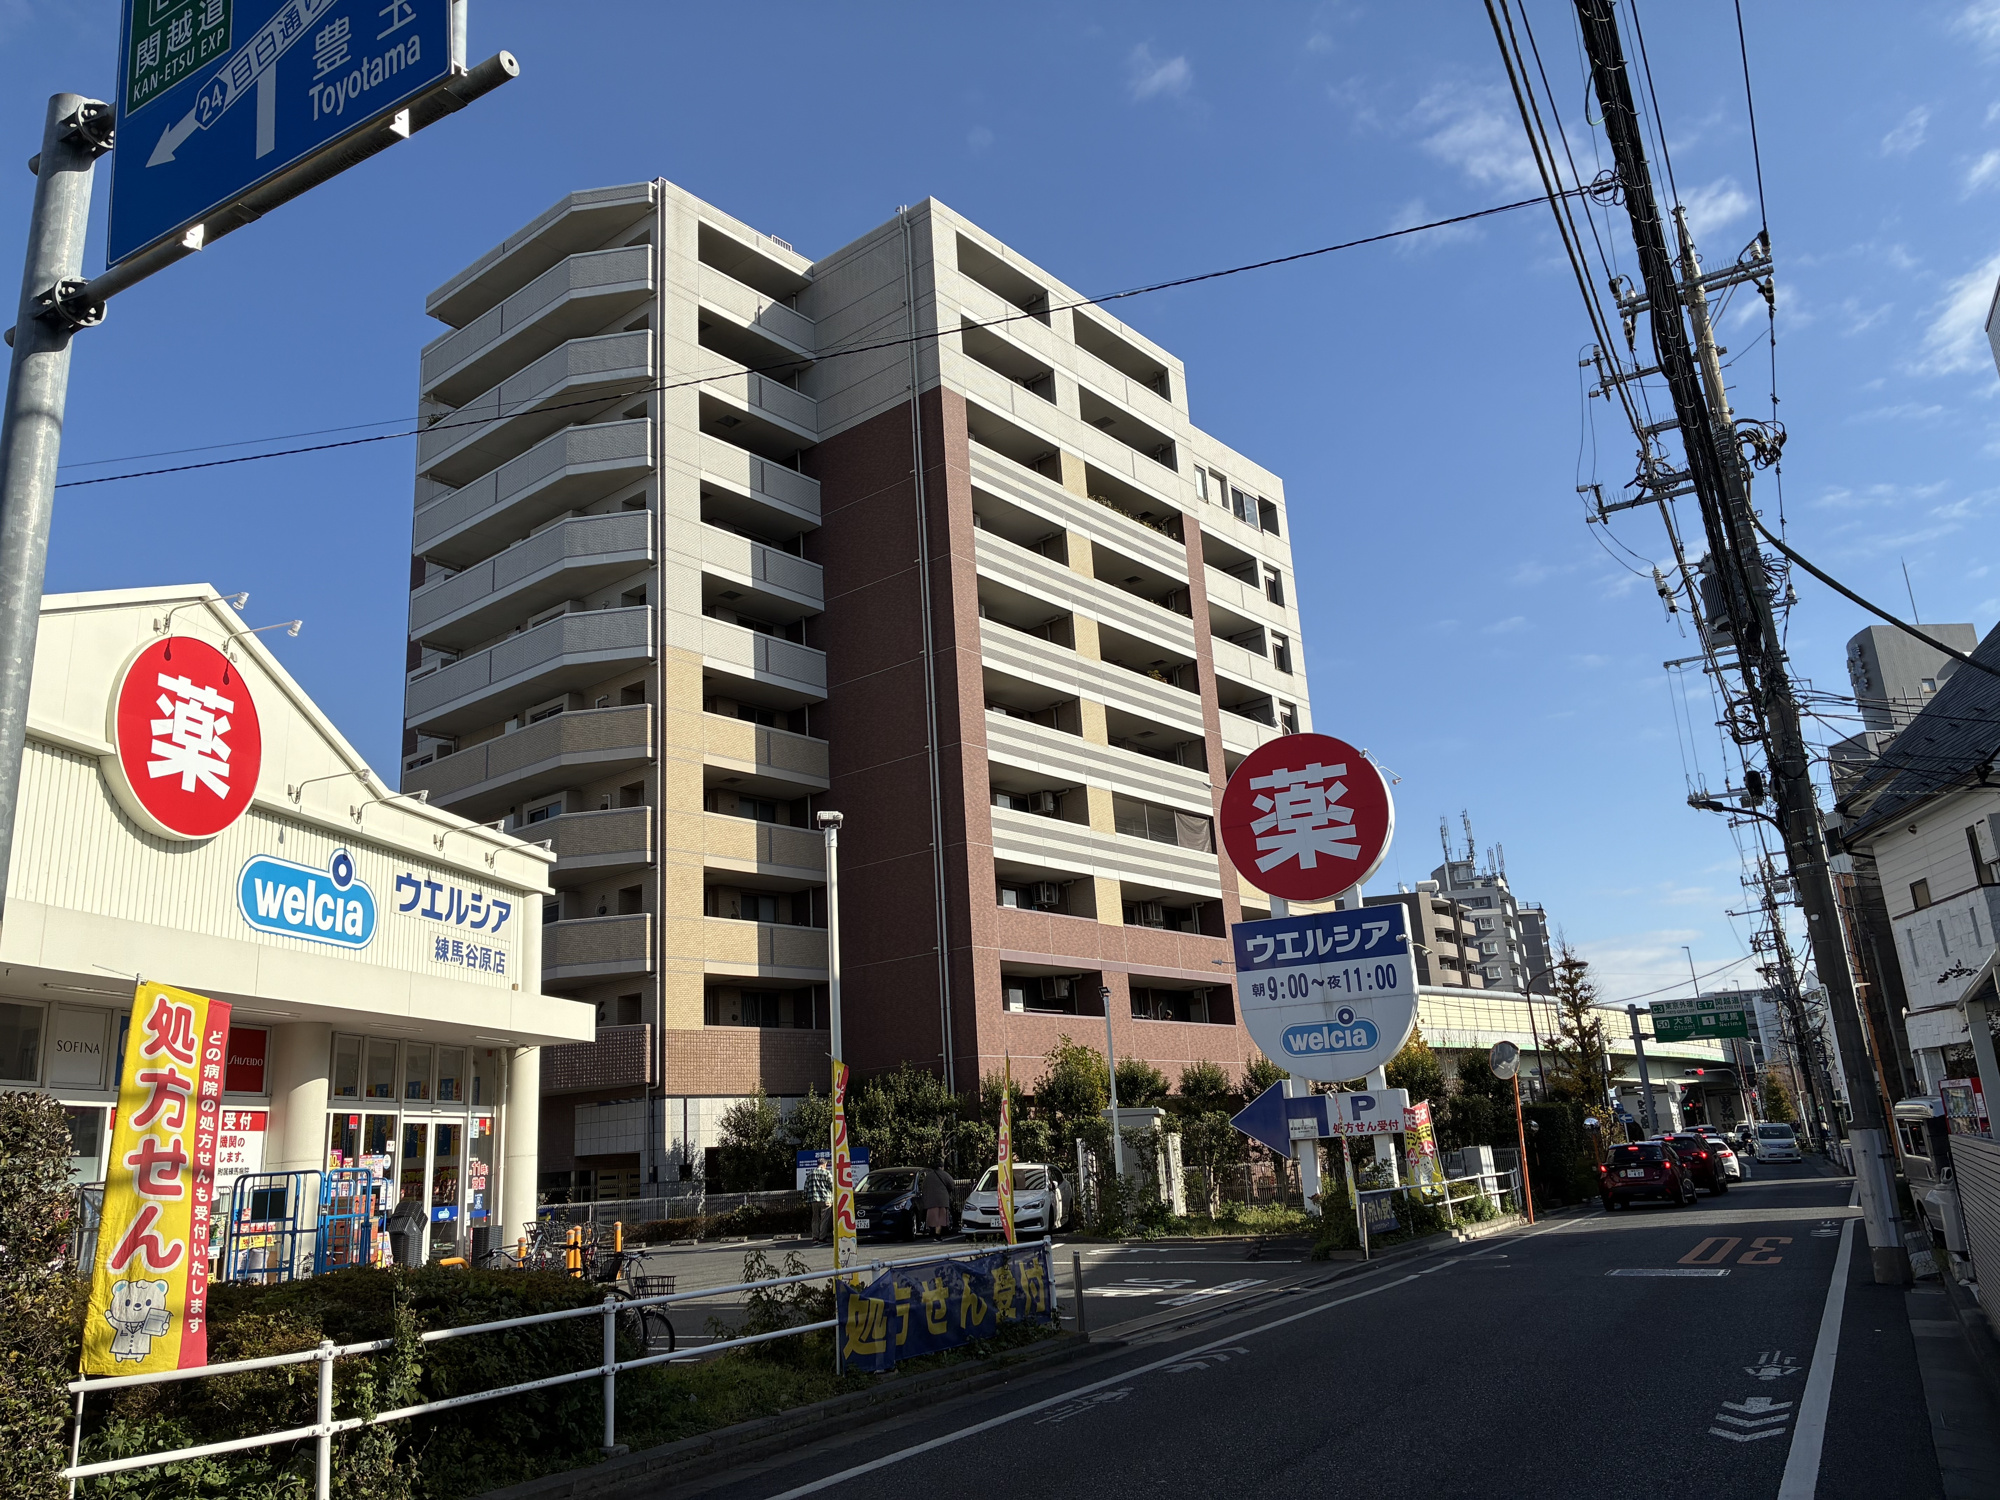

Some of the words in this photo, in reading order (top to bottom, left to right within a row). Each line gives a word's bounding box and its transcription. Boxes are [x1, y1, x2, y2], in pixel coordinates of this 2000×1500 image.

[135, 0, 225, 79] 関越道
[133, 46, 195, 103] KAN-ETSU
[201, 27, 225, 58] EXP
[308, 34, 421, 121] Toyotama
[200, 84, 223, 123] 24
[146, 672, 234, 800] 薬
[1249, 762, 1362, 874] 薬
[254, 854, 364, 937] welcia
[394, 872, 512, 934] ウエルシア
[434, 935, 506, 975] 練馬谷原店
[1245, 920, 1390, 964] ウエルシア
[1652, 1004, 1664, 1014] C3
[1657, 1020, 1669, 1028] 50
[1674, 1016, 1694, 1025] 大泉
[1697, 1001, 1713, 1010] E17
[56, 1039, 100, 1055] SOFINA
[1287, 1008, 1368, 1052] welcia
[227, 1054, 264, 1067] SHISEIDO
[223, 1112, 253, 1131] 受付
[1332, 1118, 1400, 1135] 処方せん受付
[1350, 1095, 1376, 1121] P
[108, 996, 197, 1273] 処方せん
[219, 1150, 246, 1163] します。
[189, 1030, 223, 1334] どの病院の処方せんも受付いたします
[1677, 1236, 1793, 1265] 30
